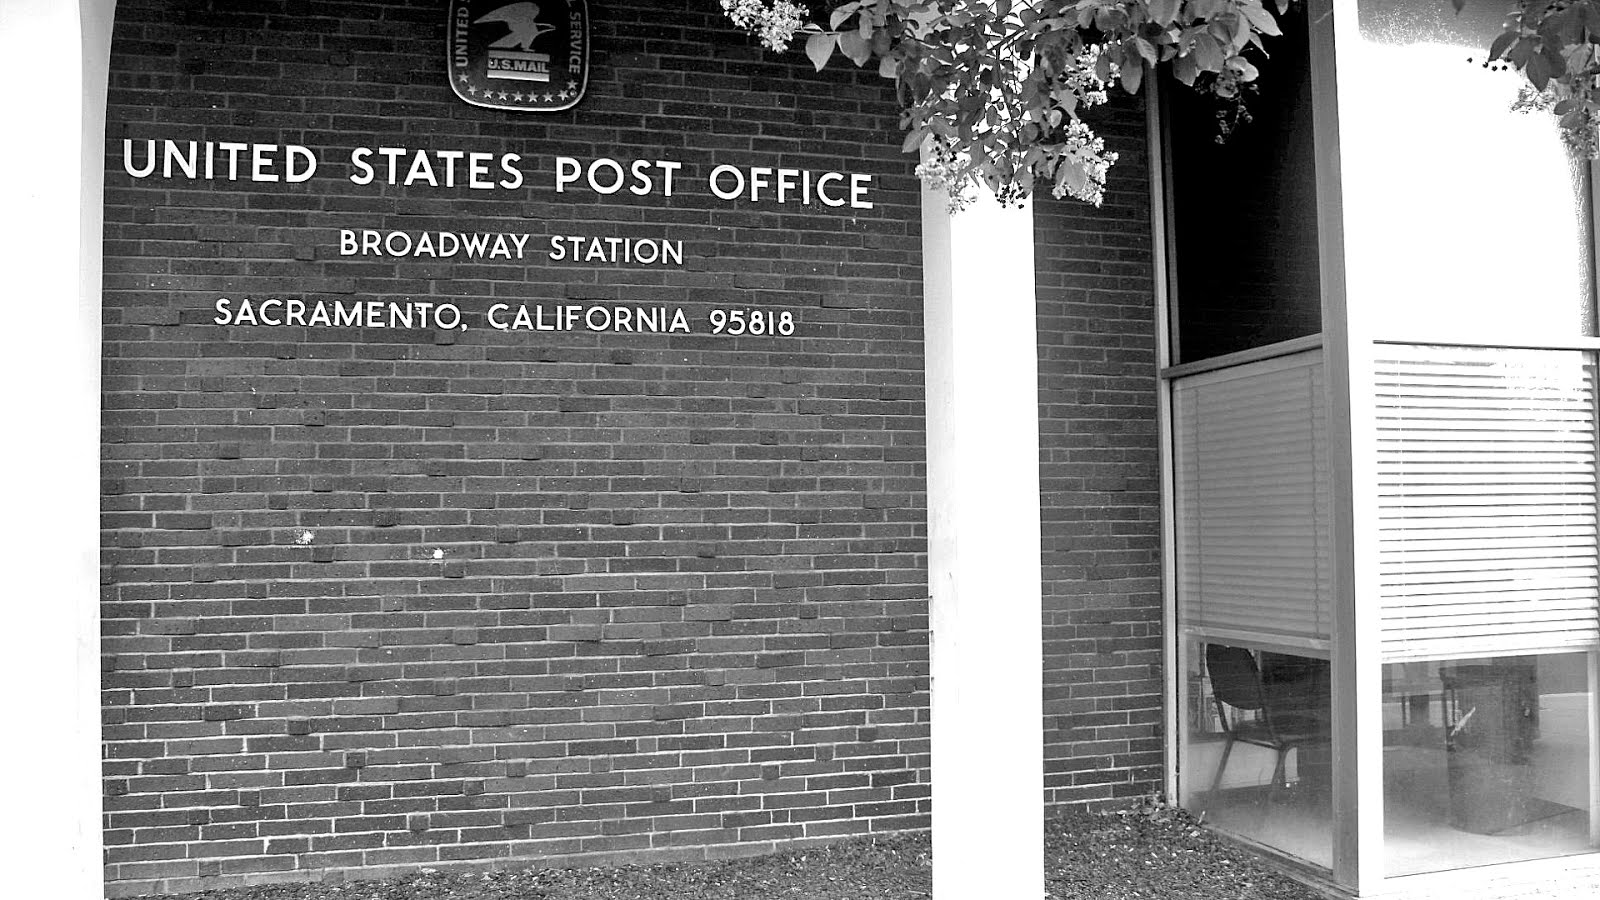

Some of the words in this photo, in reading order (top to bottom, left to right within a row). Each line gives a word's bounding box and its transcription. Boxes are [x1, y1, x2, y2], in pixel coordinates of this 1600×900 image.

[456, 7, 469, 67] UNITED
[568, 12, 582, 73] SERVICE
[123, 138, 317, 183] UNITED
[349, 147, 523, 189] STATES
[556, 156, 682, 197] POST
[709, 164, 873, 209] OFFICE
[340, 229, 530, 259] BROADWAY
[549, 235, 683, 265] STATION
[214, 298, 468, 332] SACRAMENTO,
[487, 303, 691, 333] CALIFORNIA
[709, 309, 795, 336] 95818
